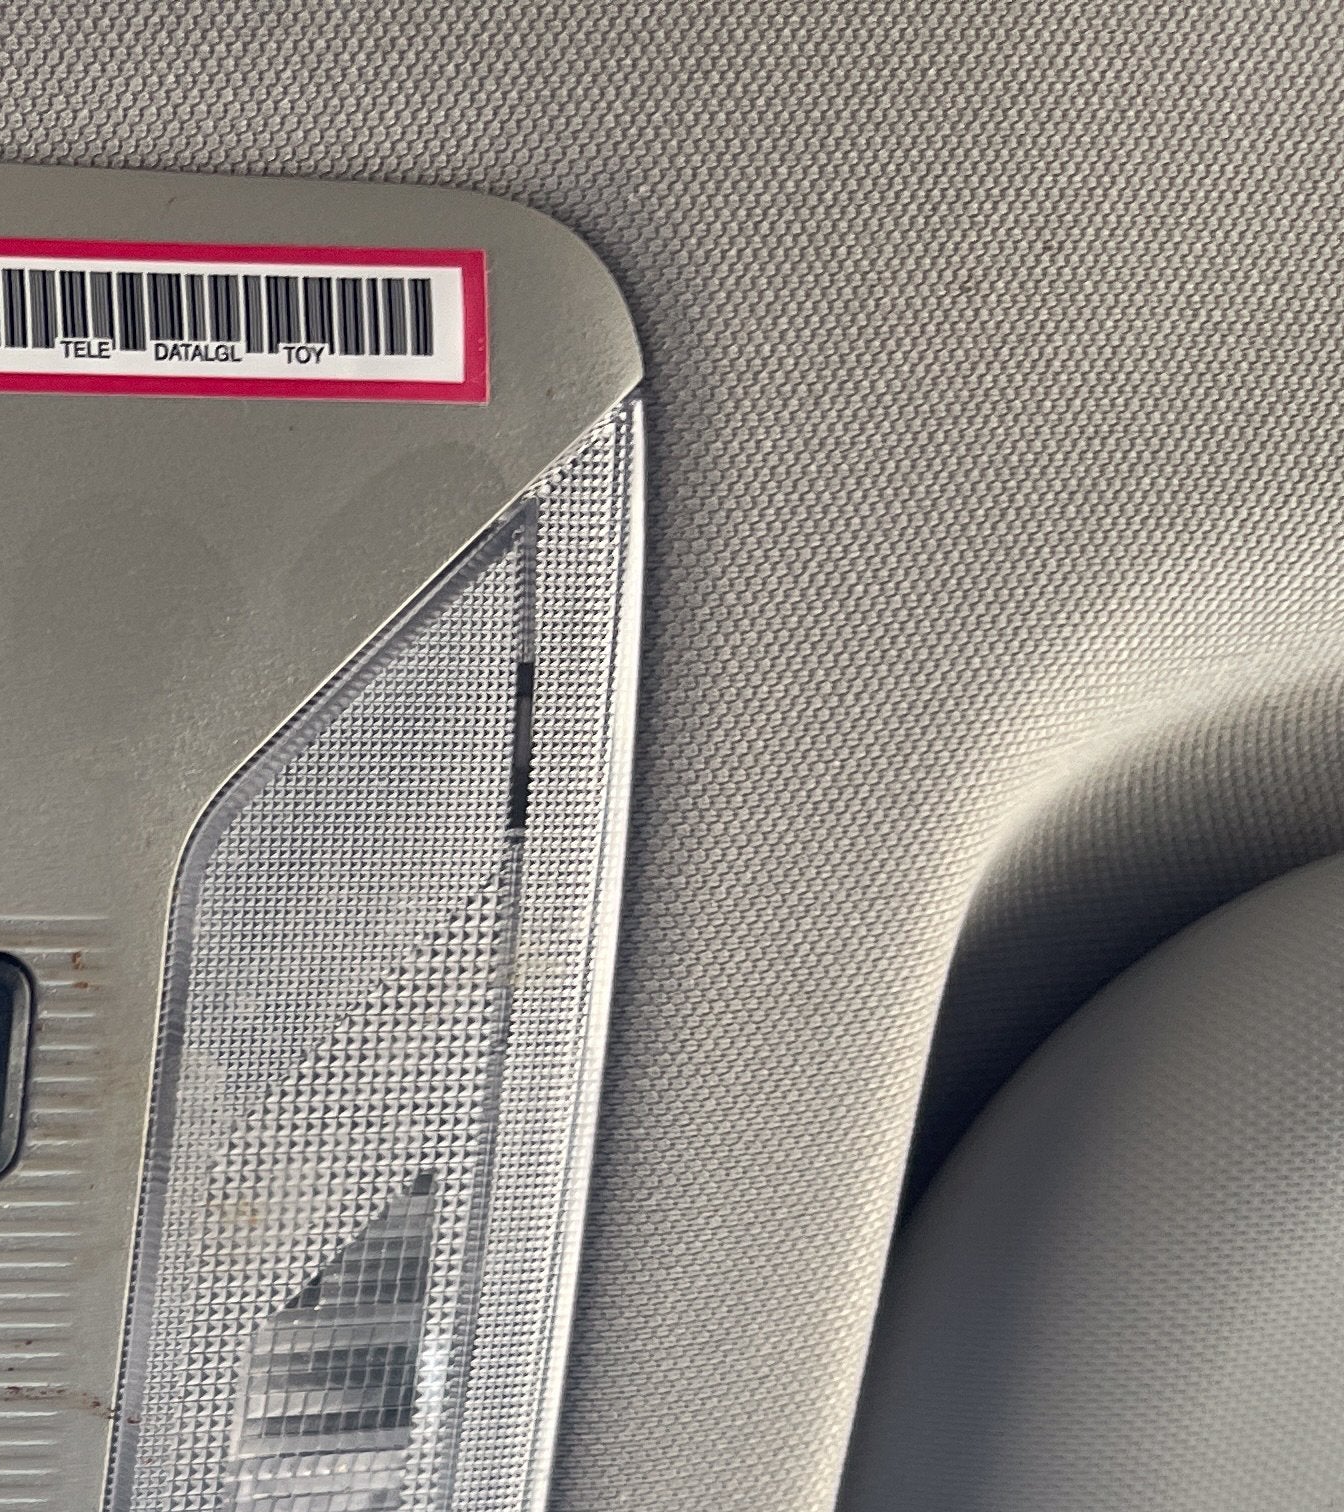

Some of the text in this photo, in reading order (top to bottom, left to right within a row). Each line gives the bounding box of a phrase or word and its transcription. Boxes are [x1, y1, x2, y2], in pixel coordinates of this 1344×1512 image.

[60, 339, 326, 364] TELE DATALGL TOY
